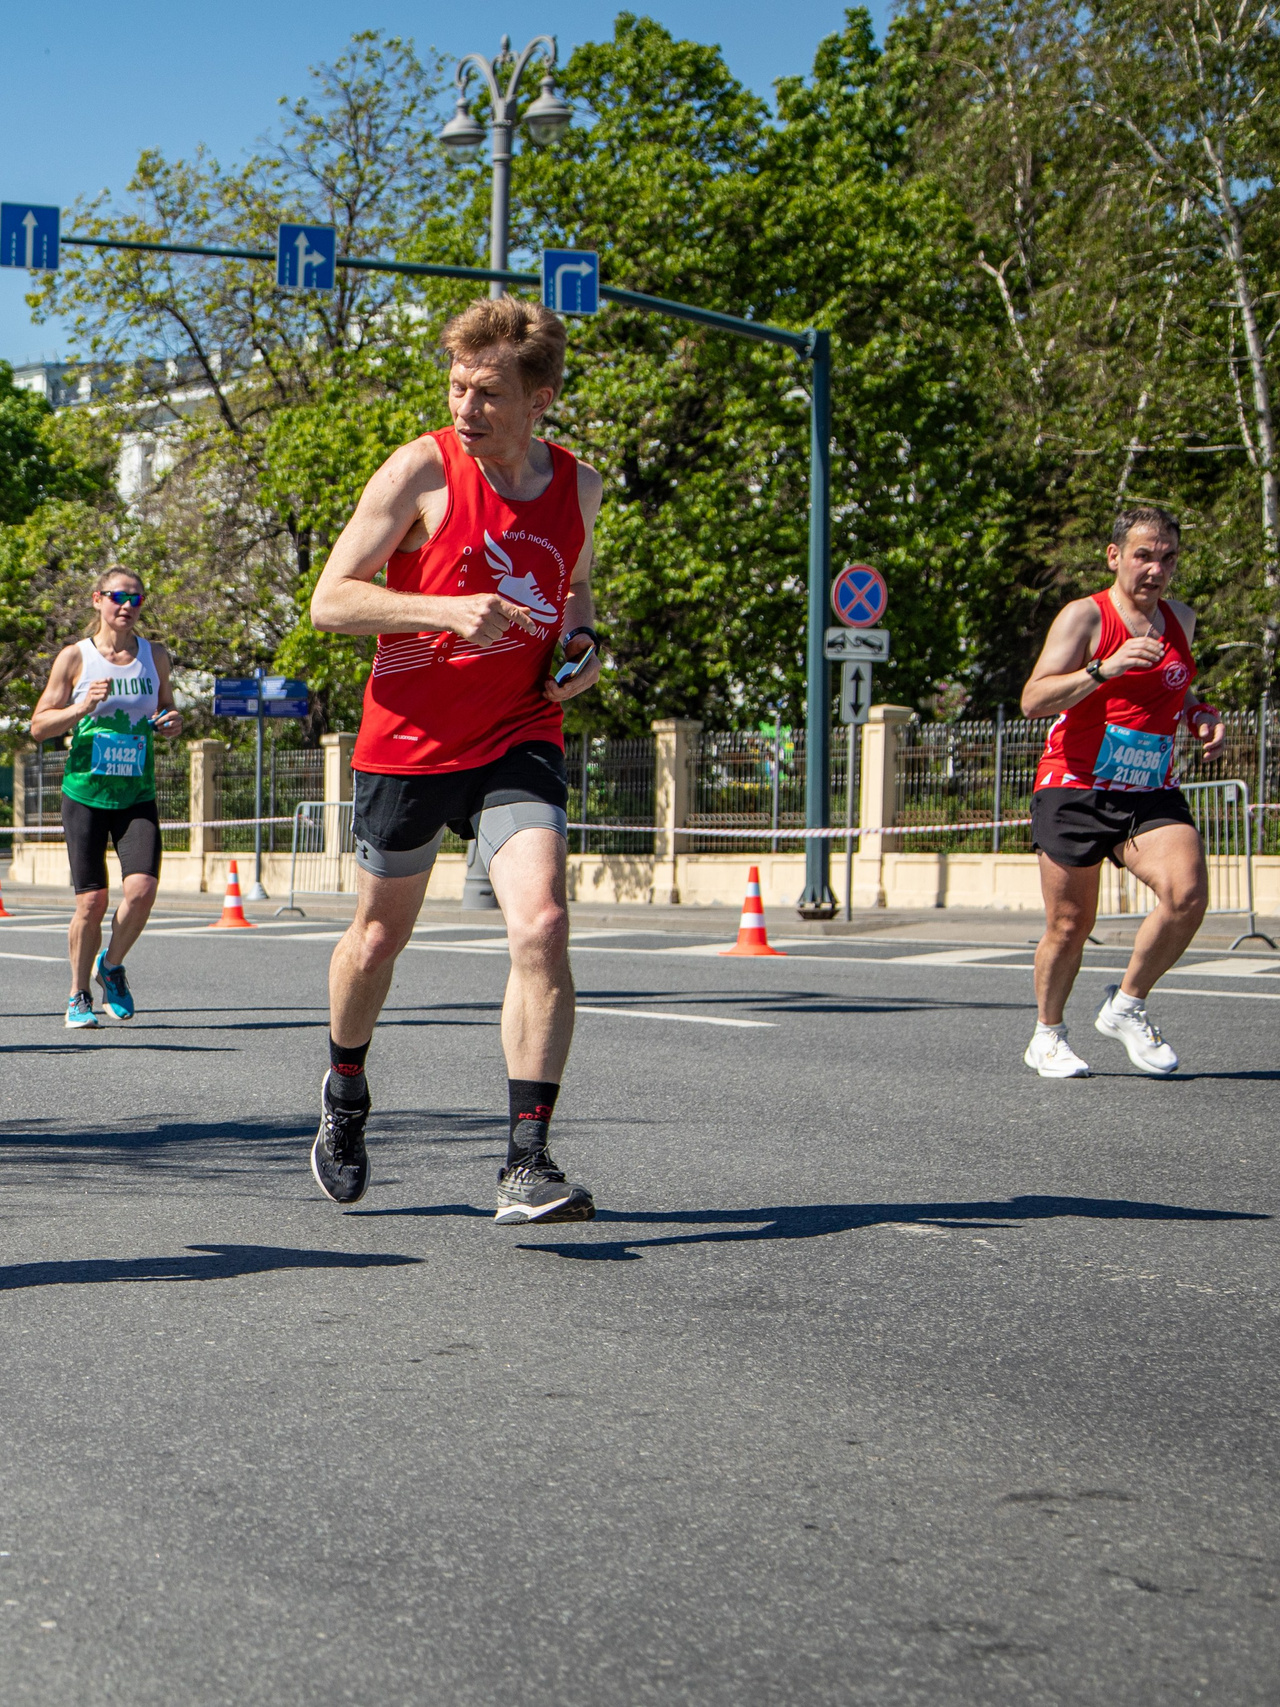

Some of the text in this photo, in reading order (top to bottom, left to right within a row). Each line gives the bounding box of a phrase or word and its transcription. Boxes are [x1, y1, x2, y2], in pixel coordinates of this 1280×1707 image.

[502, 530, 526, 541] Клуб
[527, 533, 567, 577] любителей
[103, 746, 137, 763] 41422
[1112, 745, 1162, 770] 40636
[105, 763, 133, 776] 21.1KM
[1112, 766, 1151, 786] 21.1KM
